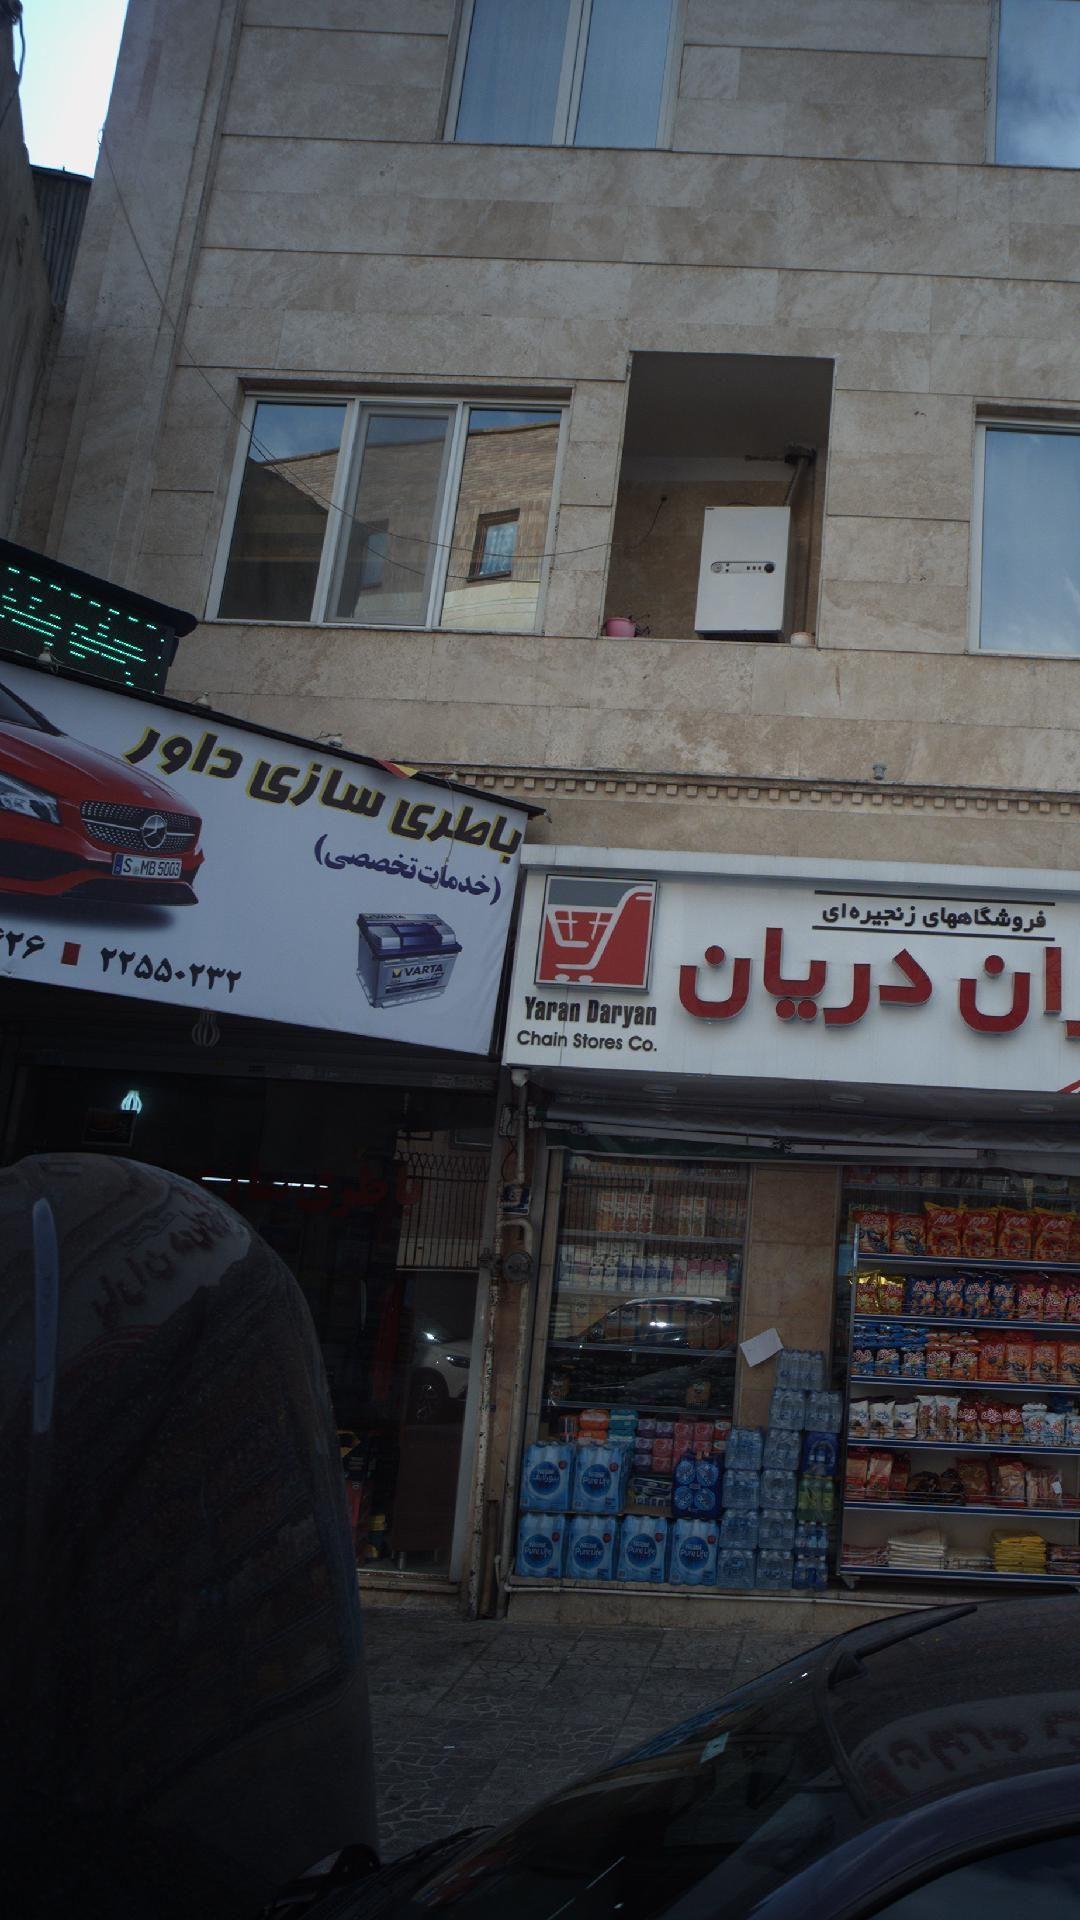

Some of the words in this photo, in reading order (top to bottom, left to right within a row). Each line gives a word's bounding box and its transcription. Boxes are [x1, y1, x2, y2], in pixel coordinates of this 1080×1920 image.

[122, 726, 244, 779] داور
[246, 759, 387, 818] سازی
[388, 800, 522, 864] باطری
[123, 858, 133, 873] S
[100, 947, 242, 993] ۲۲۵۵۰۲۳۲
[404, 963, 444, 977] VARTA
[679, 927, 934, 1028] دریان
[960, 946, 1080, 1037] ان
[525, 996, 581, 1022] Yaran
[586, 1000, 657, 1028] Daryan
[517, 1030, 567, 1047] Chain
[572, 1033, 623, 1050] Stores
[628, 1035, 658, 1052] Co.
